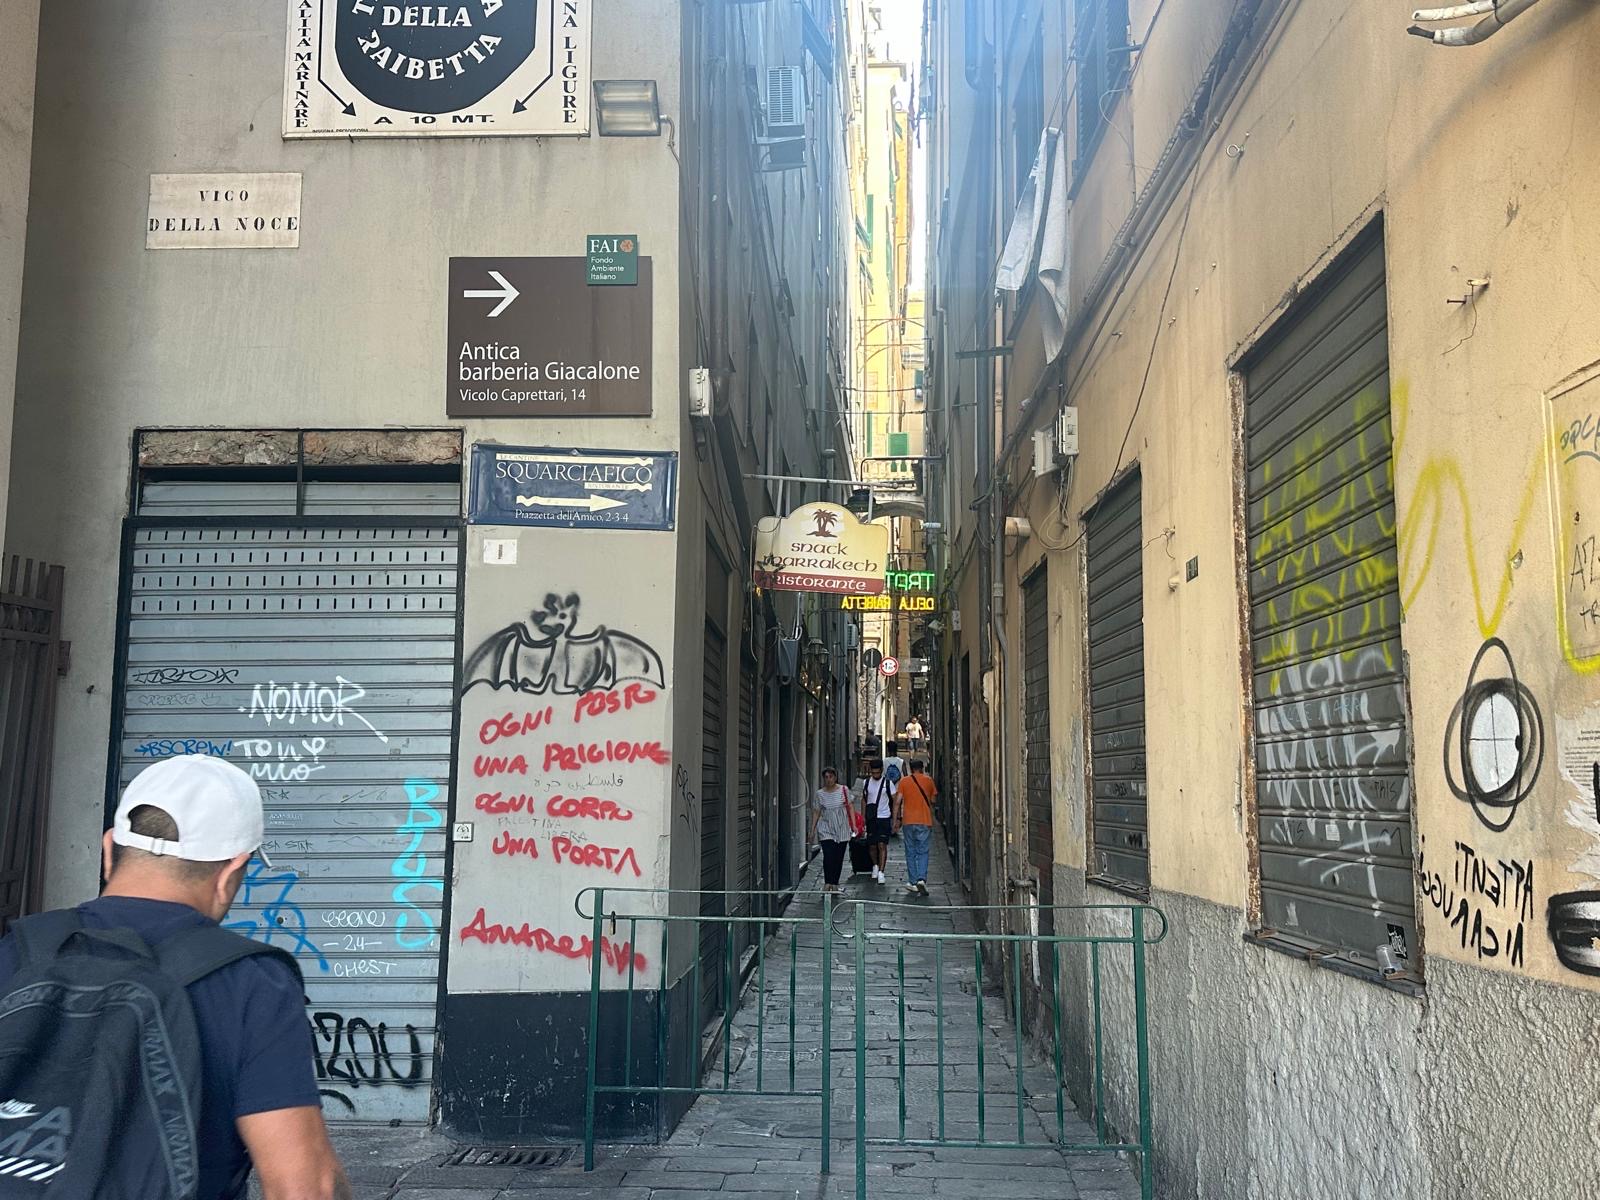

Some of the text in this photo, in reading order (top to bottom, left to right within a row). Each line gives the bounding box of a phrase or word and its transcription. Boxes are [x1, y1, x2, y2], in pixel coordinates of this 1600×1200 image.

[382, 6, 472, 27] DELLA
[357, 29, 502, 81] RAIBETTA
[294, 52, 312, 128] MARINARE
[562, 36, 577, 124] LIGURE
[374, 115, 495, 125] A 10 MT.
[199, 190, 249, 202] VICO
[149, 217, 298, 232] DELLA NOCE
[590, 239, 618, 253] FAI
[459, 342, 520, 360] Antica
[459, 361, 640, 381] barberia Giacalone
[459, 388, 586, 403] Vicolo Caprettari, 14
[496, 461, 653, 484] SQUARCIAFICO
[514, 509, 555, 520] Piazzetta
[605, 513, 629, 522] 2-3-4
[791, 542, 848, 556] snack
[479, 706, 553, 744] OGNI
[473, 740, 672, 778] UNA PRIGIONE
[475, 792, 633, 821] OGNI CORPO
[492, 830, 539, 859] UNA
[552, 836, 641, 877] PORTA
